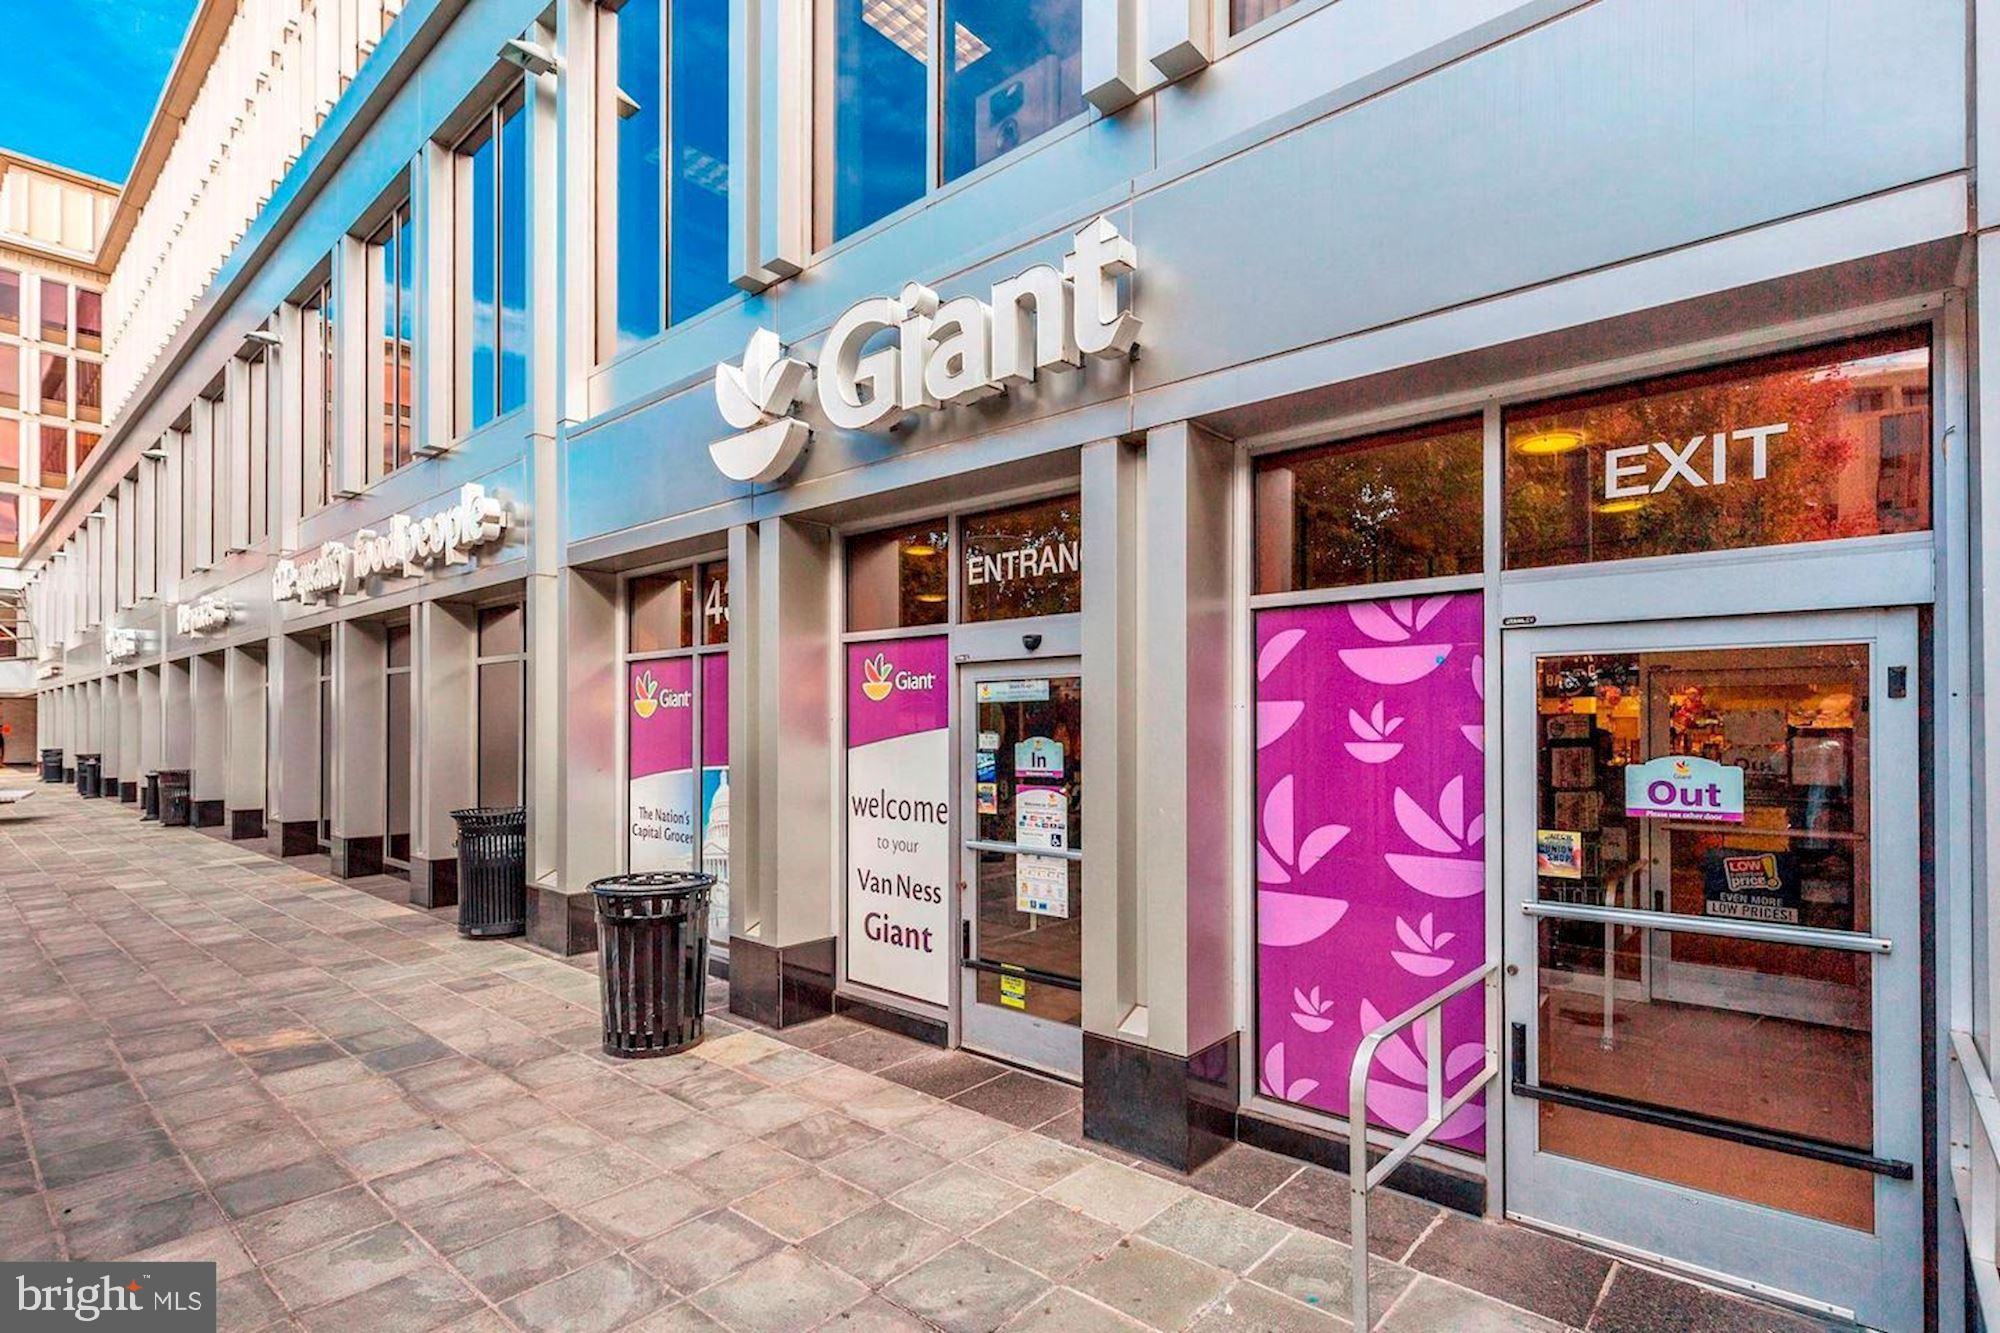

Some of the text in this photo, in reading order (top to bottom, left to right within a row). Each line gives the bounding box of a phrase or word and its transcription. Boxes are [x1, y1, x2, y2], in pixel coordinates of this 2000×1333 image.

[817, 216, 1143, 431] Giant
[1605, 422, 1788, 499] EXIT
[968, 540, 1081, 586] ENTRAN
[895, 671, 935, 690] Giant
[659, 689, 691, 708] Giant
[1032, 752, 1046, 767] In
[1647, 780, 1721, 807] Out
[639, 806, 690, 825] The Nation's
[852, 788, 948, 825] welcome
[632, 823, 662, 840] Capital
[877, 836, 919, 854] to your
[1728, 860, 1761, 872] LOW
[857, 867, 942, 904] Van Ness
[1719, 891, 1784, 907] EVEN MORE
[1712, 902, 1792, 921] LOW PRICES!
[864, 912, 933, 953] Giant
